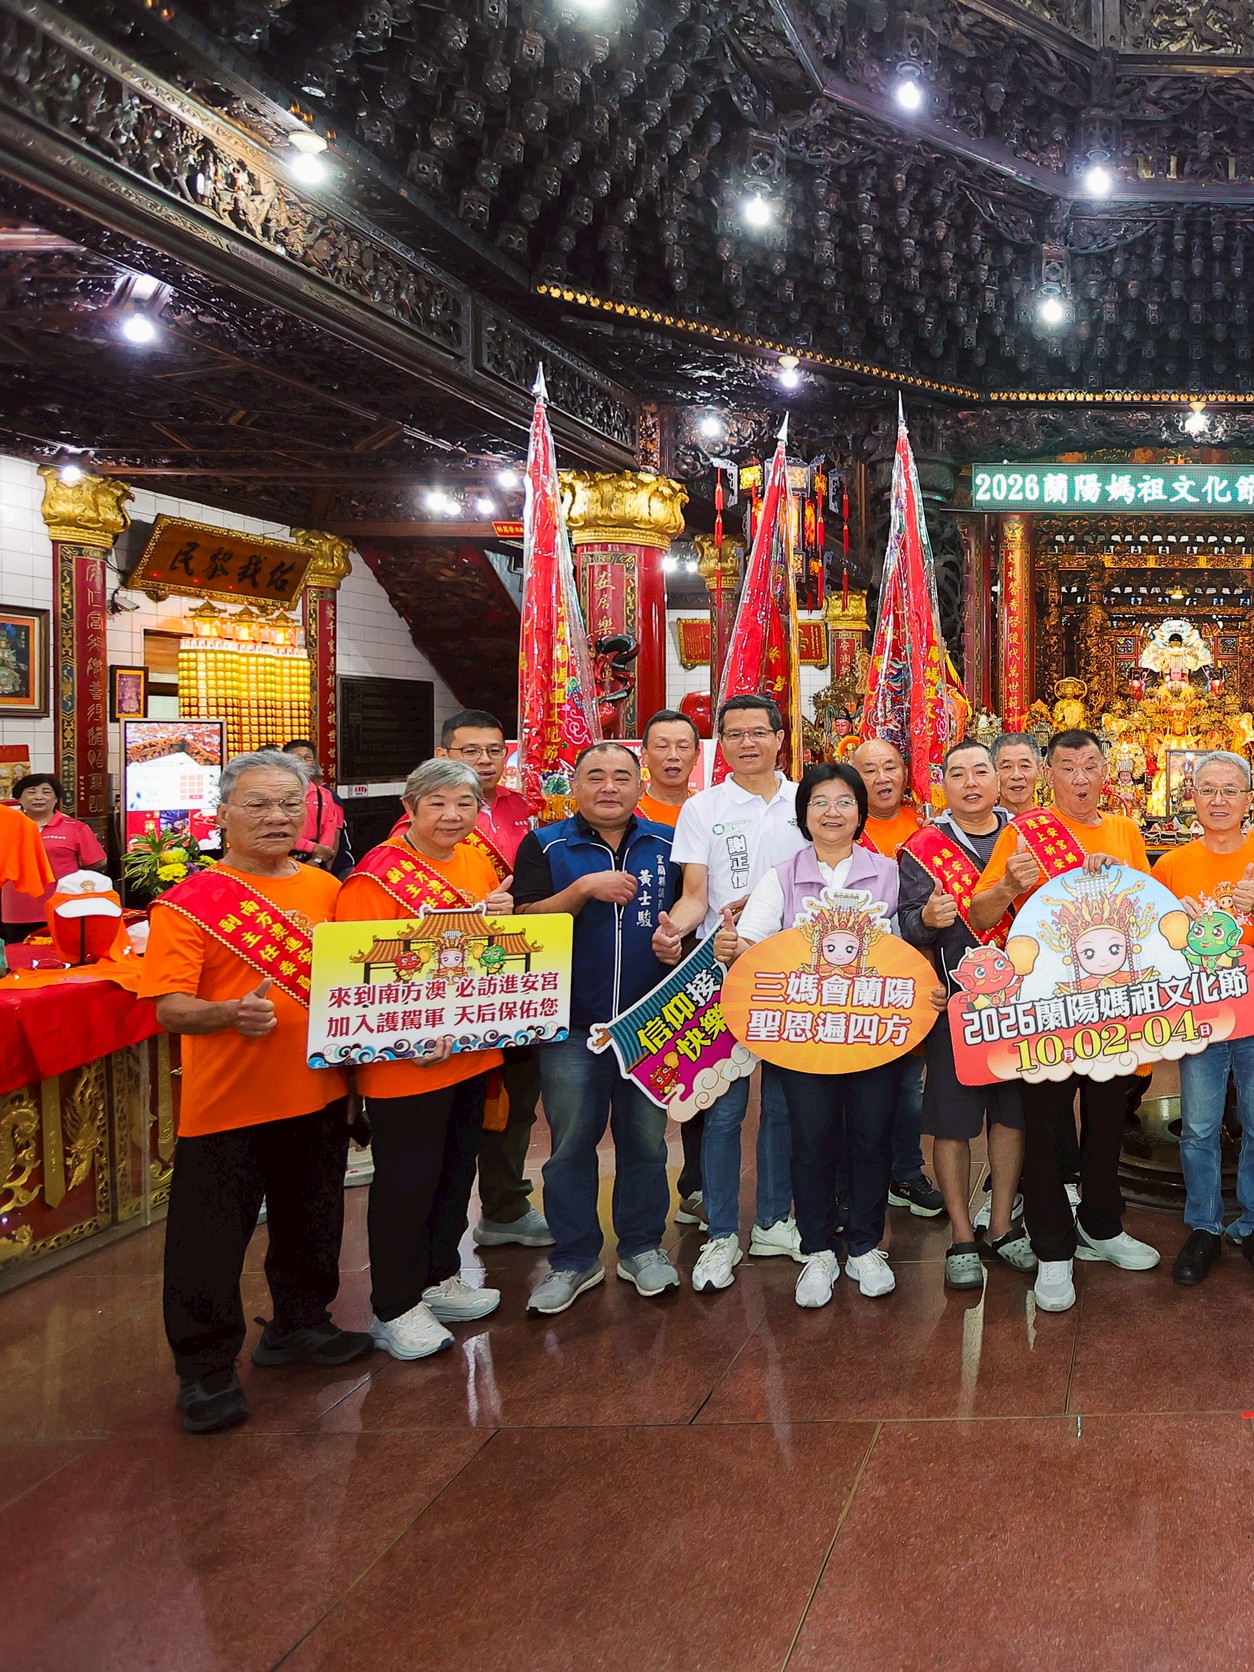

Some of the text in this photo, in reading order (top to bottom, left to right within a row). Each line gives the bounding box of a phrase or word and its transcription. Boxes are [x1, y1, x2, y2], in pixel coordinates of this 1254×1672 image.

[726, 834, 750, 890] 謝正信
[636, 869, 654, 928] 黃士駿
[328, 971, 560, 1009] 來到南方澳 必訪進安宮
[636, 957, 727, 1056] 信仰接
[751, 971, 916, 1009] 三媽會蘭陽
[961, 965, 1249, 1046] 2026蘭陽媽祖文化節
[326, 997, 559, 1038] 加入護駕軍 天后保佑您
[746, 1008, 912, 1046] 聖恩遍四方
